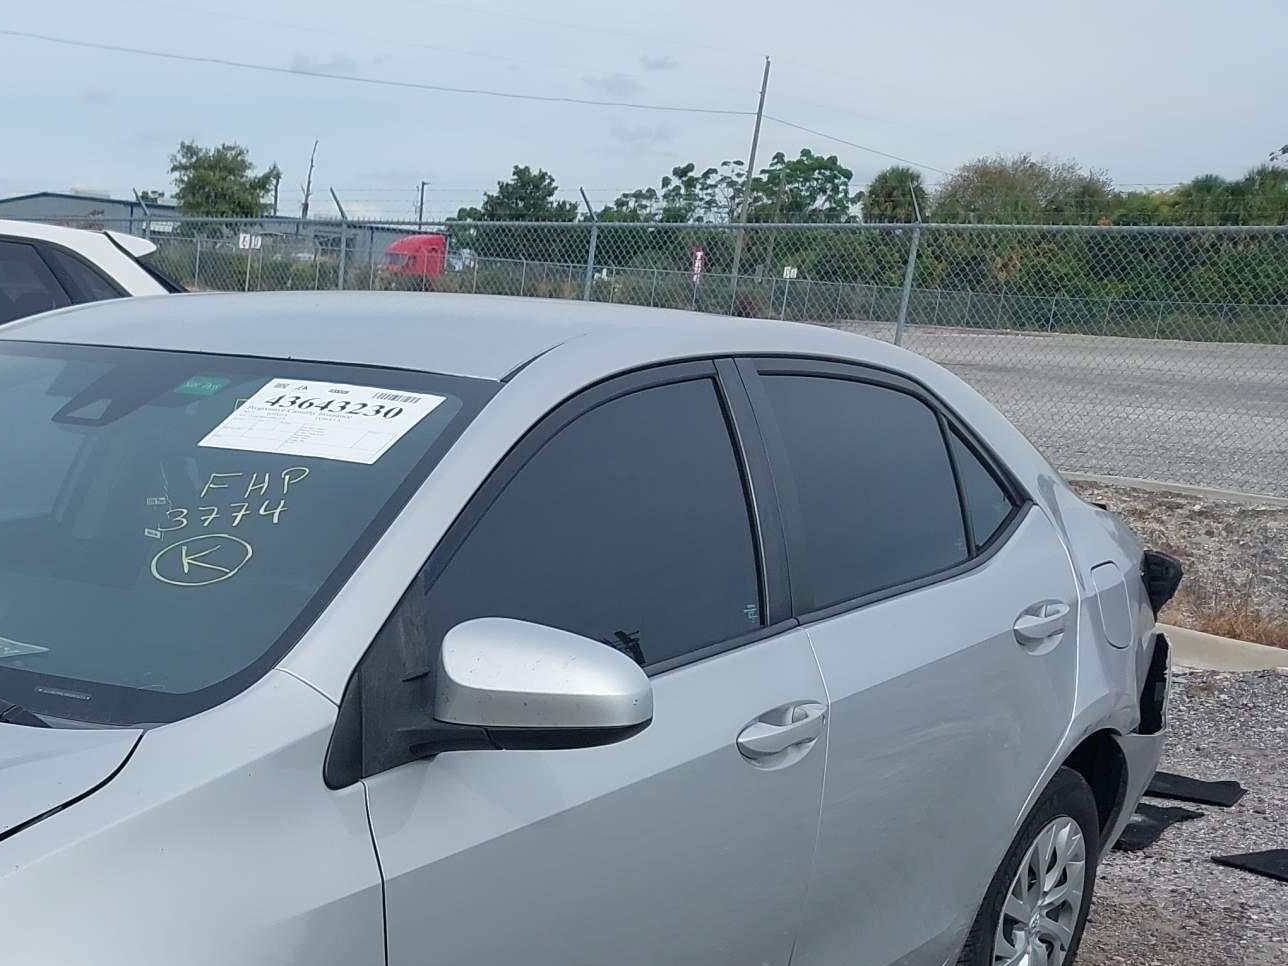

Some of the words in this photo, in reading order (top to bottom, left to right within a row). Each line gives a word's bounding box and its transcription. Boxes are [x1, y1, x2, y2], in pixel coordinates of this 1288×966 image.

[264, 393, 404, 420] 43643230
[200, 466, 310, 499] FHP
[157, 499, 289, 531] 3774
[181, 544, 232, 574] K
